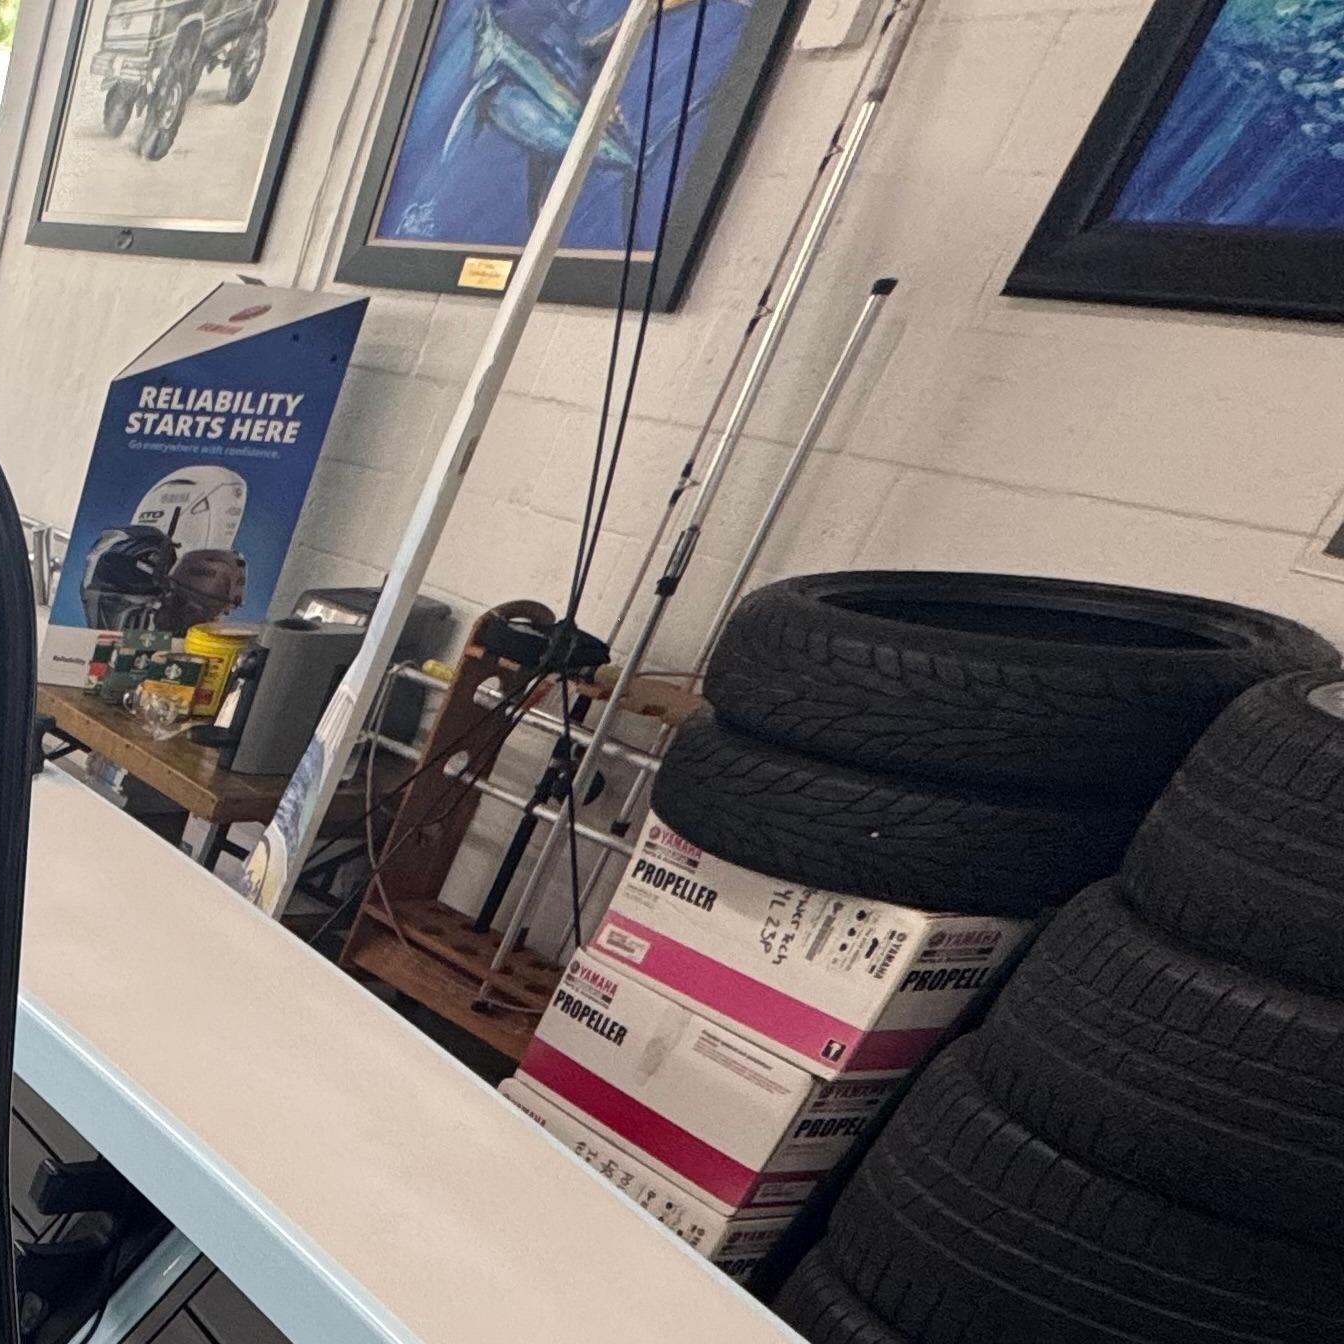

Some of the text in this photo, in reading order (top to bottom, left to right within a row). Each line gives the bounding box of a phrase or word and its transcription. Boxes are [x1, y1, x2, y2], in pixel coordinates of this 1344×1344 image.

[138, 386, 304, 417] RELIABILITY
[125, 411, 301, 444] STARTS HERE
[128, 439, 142, 450] Go
[661, 829, 703, 858] YAMAHA
[631, 858, 718, 913] PROPELLER
[872, 942, 903, 980] YAMAHA
[579, 966, 620, 995] YAMAHA
[553, 989, 629, 1047] PROPELLER
